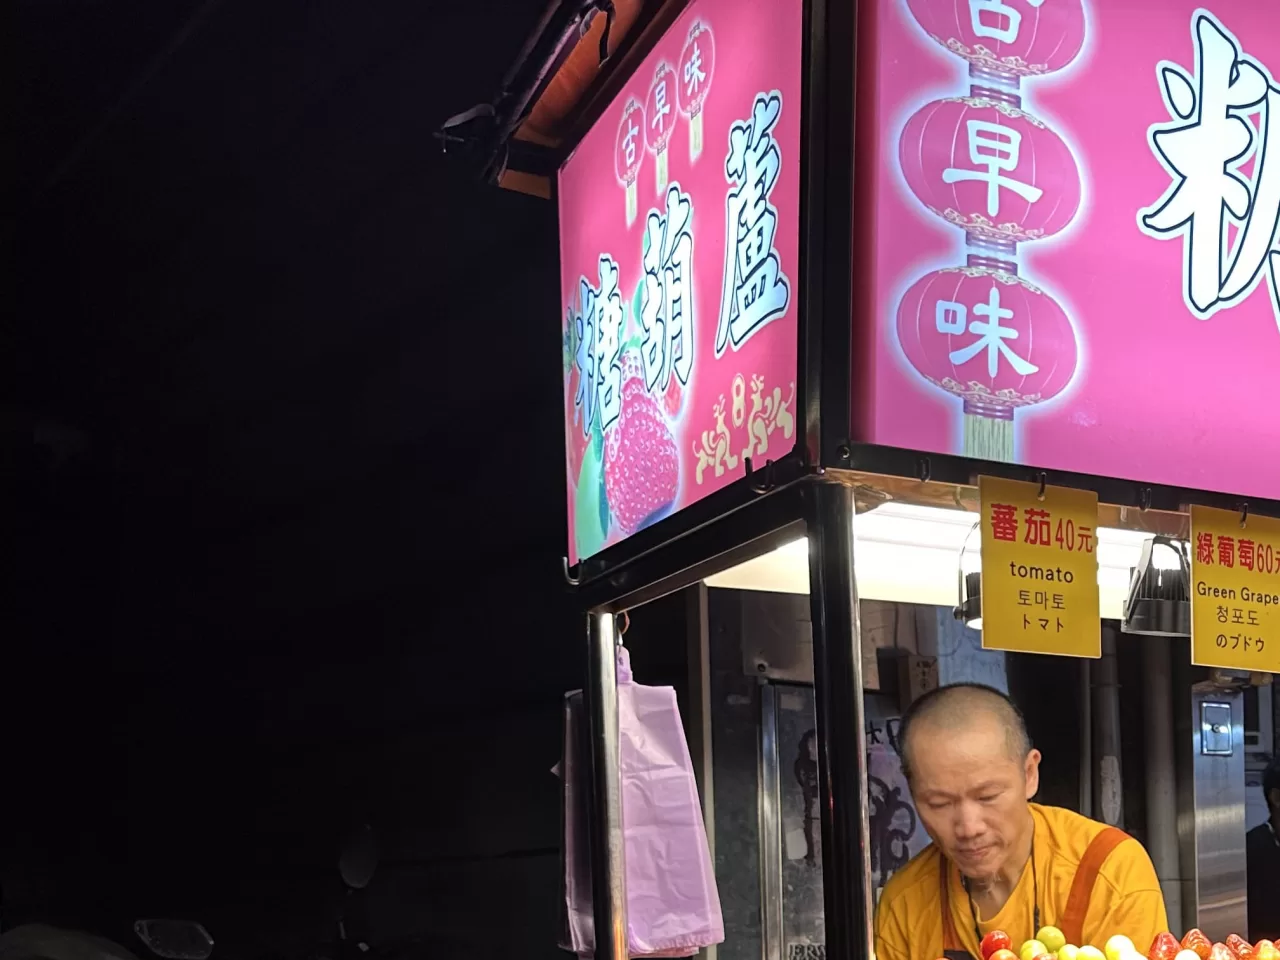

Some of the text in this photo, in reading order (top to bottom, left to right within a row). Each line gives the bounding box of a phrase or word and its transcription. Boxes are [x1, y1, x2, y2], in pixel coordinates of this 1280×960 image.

[621, 41, 706, 168] 古早味
[574, 89, 789, 437] 糖葫蘆
[1009, 561, 1074, 583] tomato
[1017, 589, 1066, 610] 토마토
[1197, 582, 1236, 600] Green
[1023, 614, 1064, 633] トマト
[1216, 606, 1260, 626] 청포도
[1216, 633, 1265, 653] のブドウ
